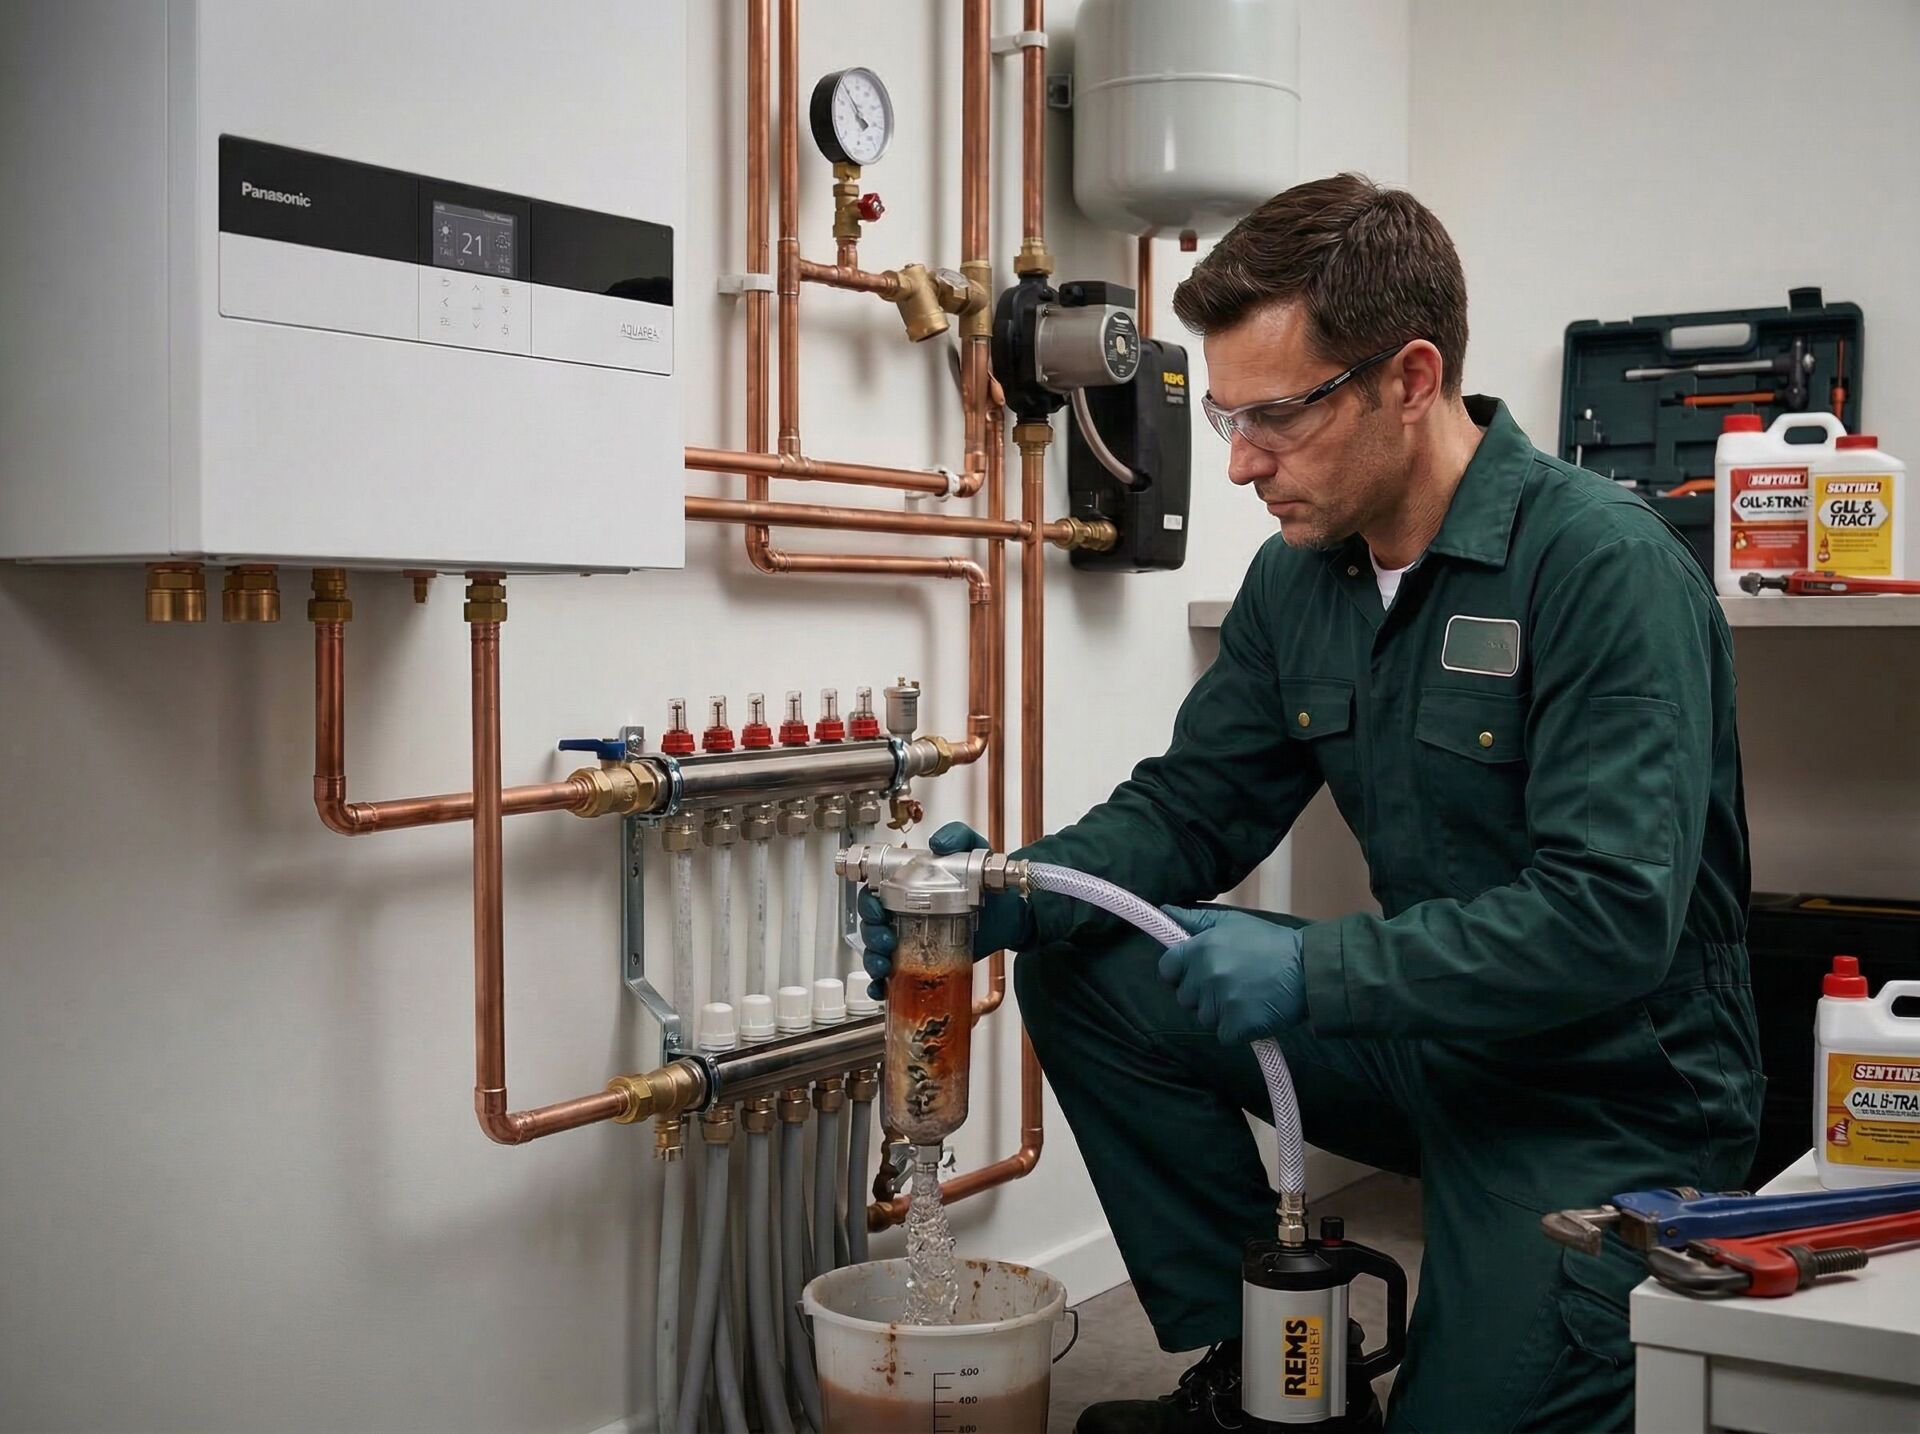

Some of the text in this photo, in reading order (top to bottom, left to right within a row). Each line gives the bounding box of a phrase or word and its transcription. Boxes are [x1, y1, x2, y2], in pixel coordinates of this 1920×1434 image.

[241, 181, 312, 207] Panasonic
[462, 232, 482, 257] 21
[1830, 514, 1876, 526] TRACT
[1852, 1092, 1878, 1109] CAL
[1284, 1319, 1308, 1396] REMS
